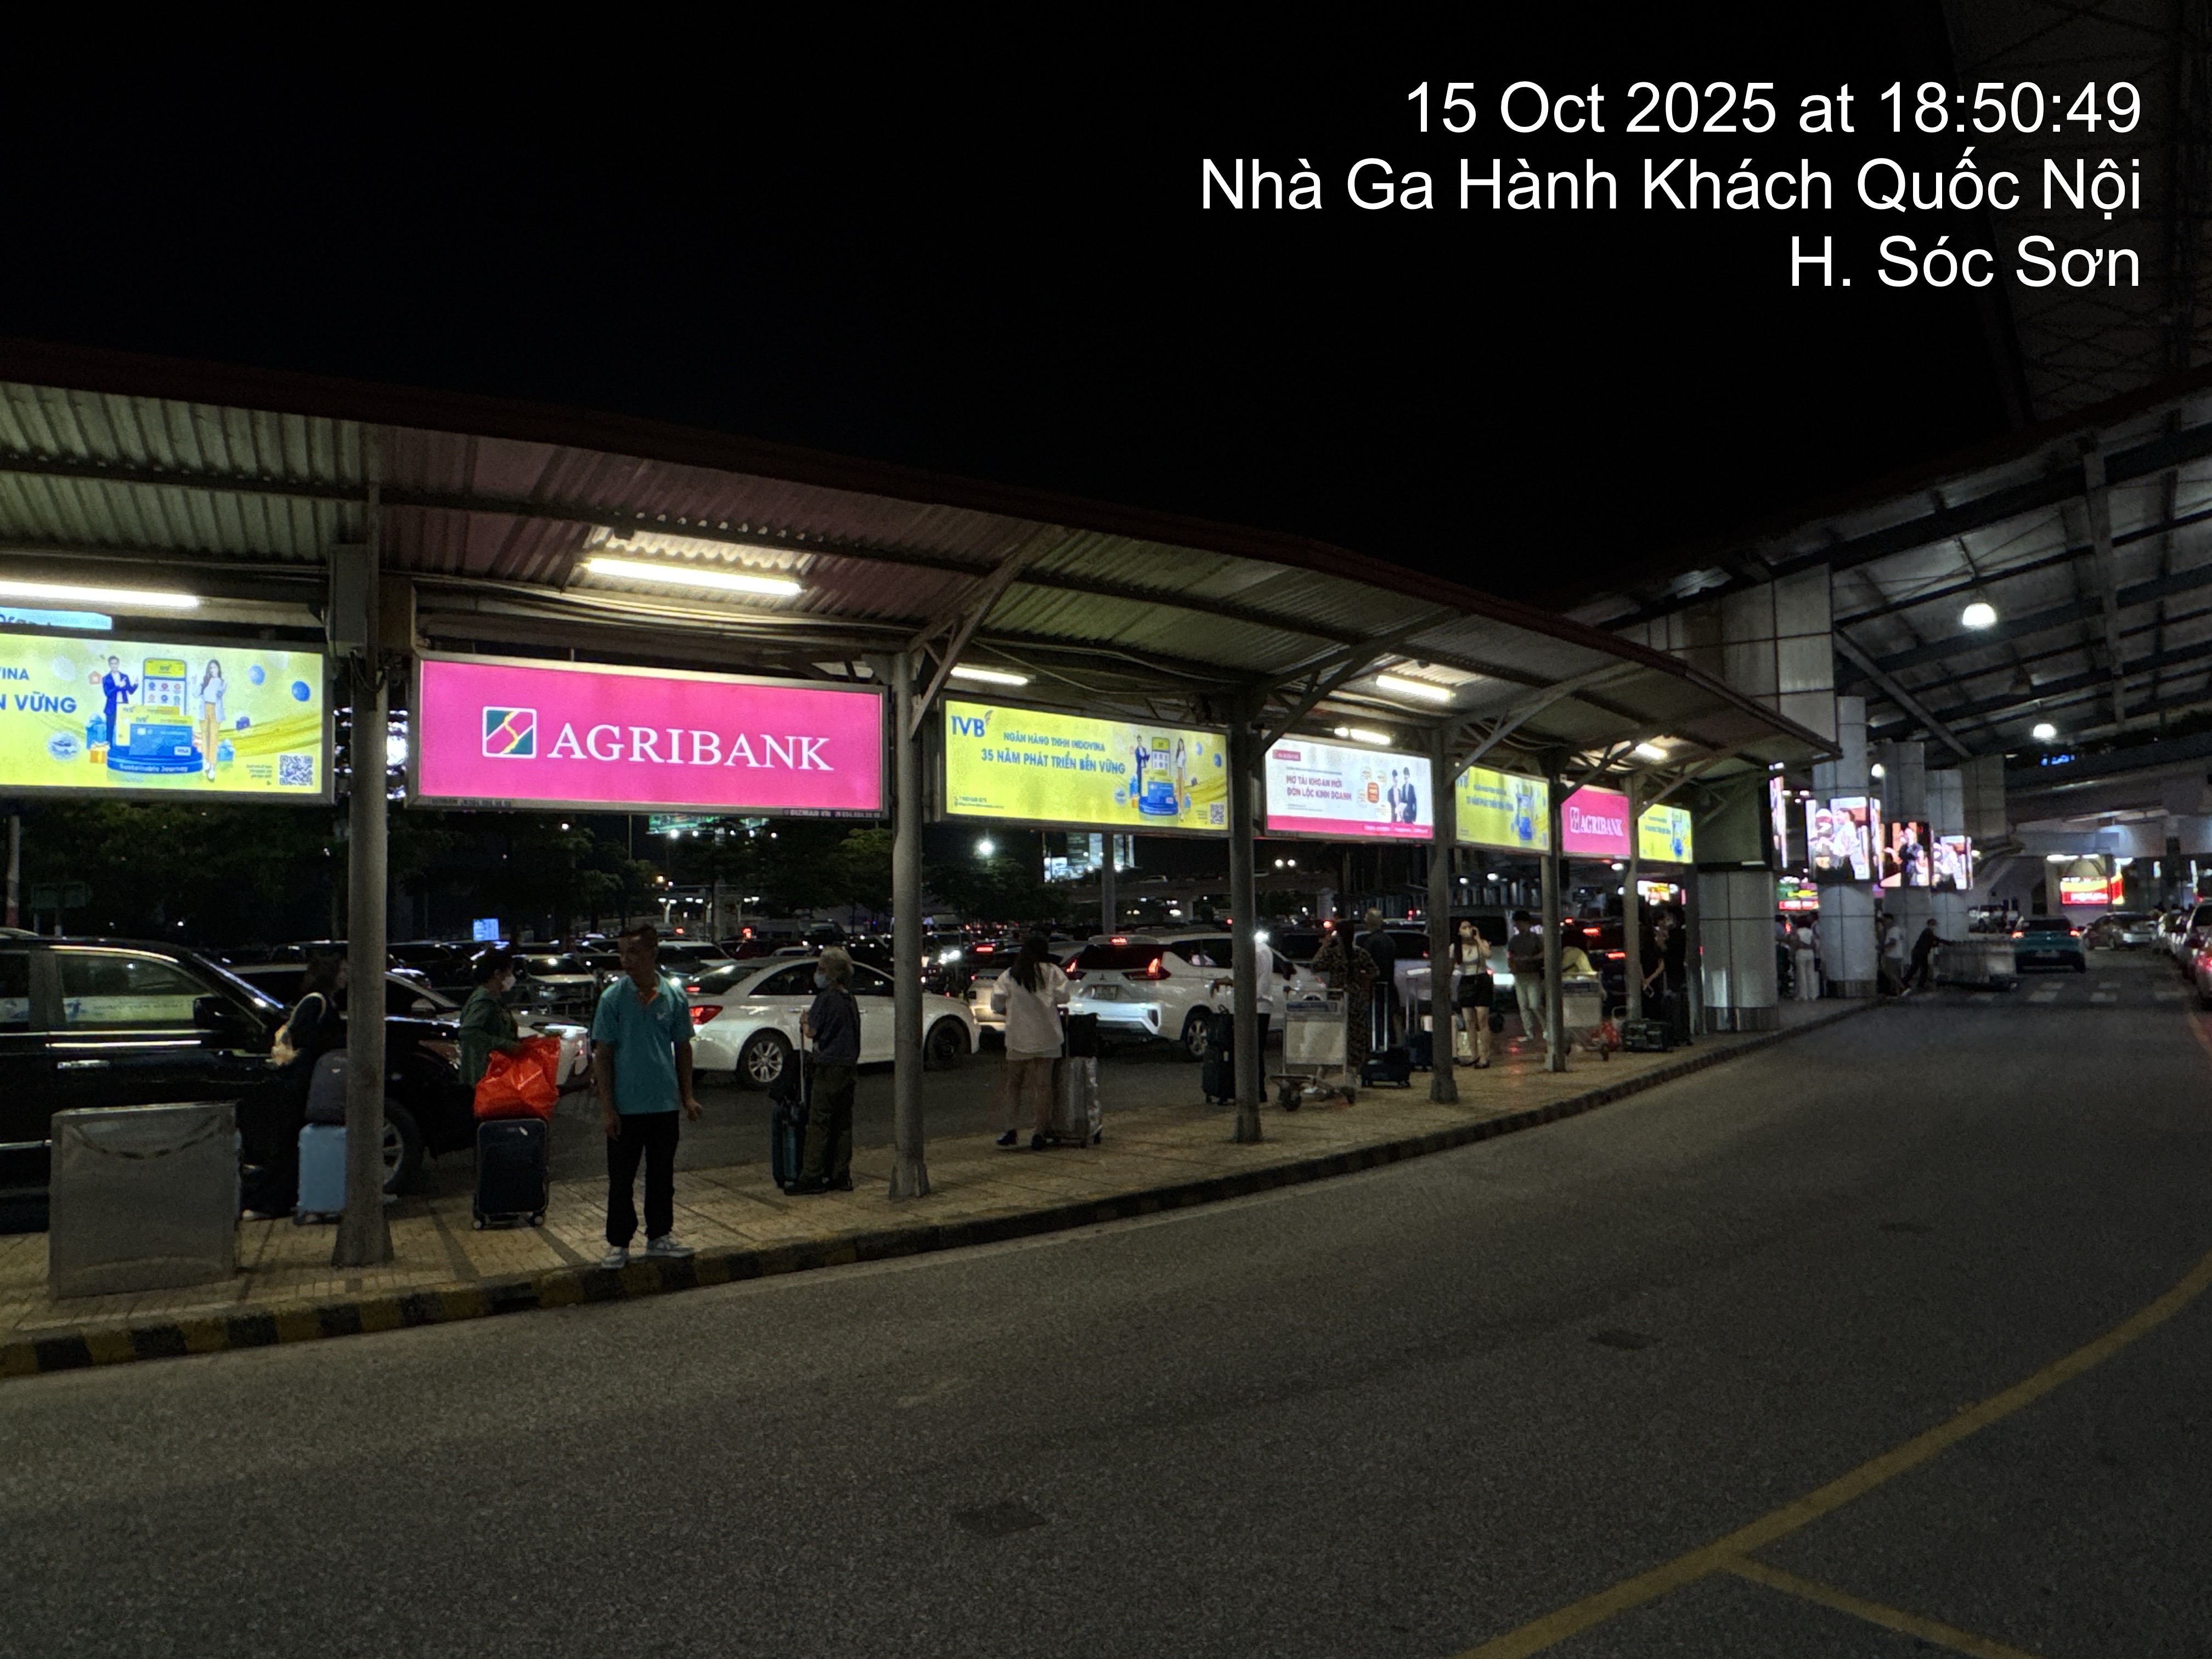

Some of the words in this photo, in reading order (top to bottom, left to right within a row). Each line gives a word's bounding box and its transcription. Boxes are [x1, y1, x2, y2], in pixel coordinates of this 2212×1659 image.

[0, 667, 30, 681] INA
[14, 691, 77, 714] VỮNG
[951, 715, 985, 737] IVB
[1003, 730, 1026, 743] NGÂN
[546, 722, 835, 771] AGRIBANK
[981, 748, 994, 761] 35
[997, 747, 1020, 764] NĂM
[1023, 751, 1049, 767] PHÁT
[1051, 751, 1076, 770] TRIỂN
[1098, 758, 1125, 775] VỮNG
[1579, 815, 1624, 837] AGRIBANK
